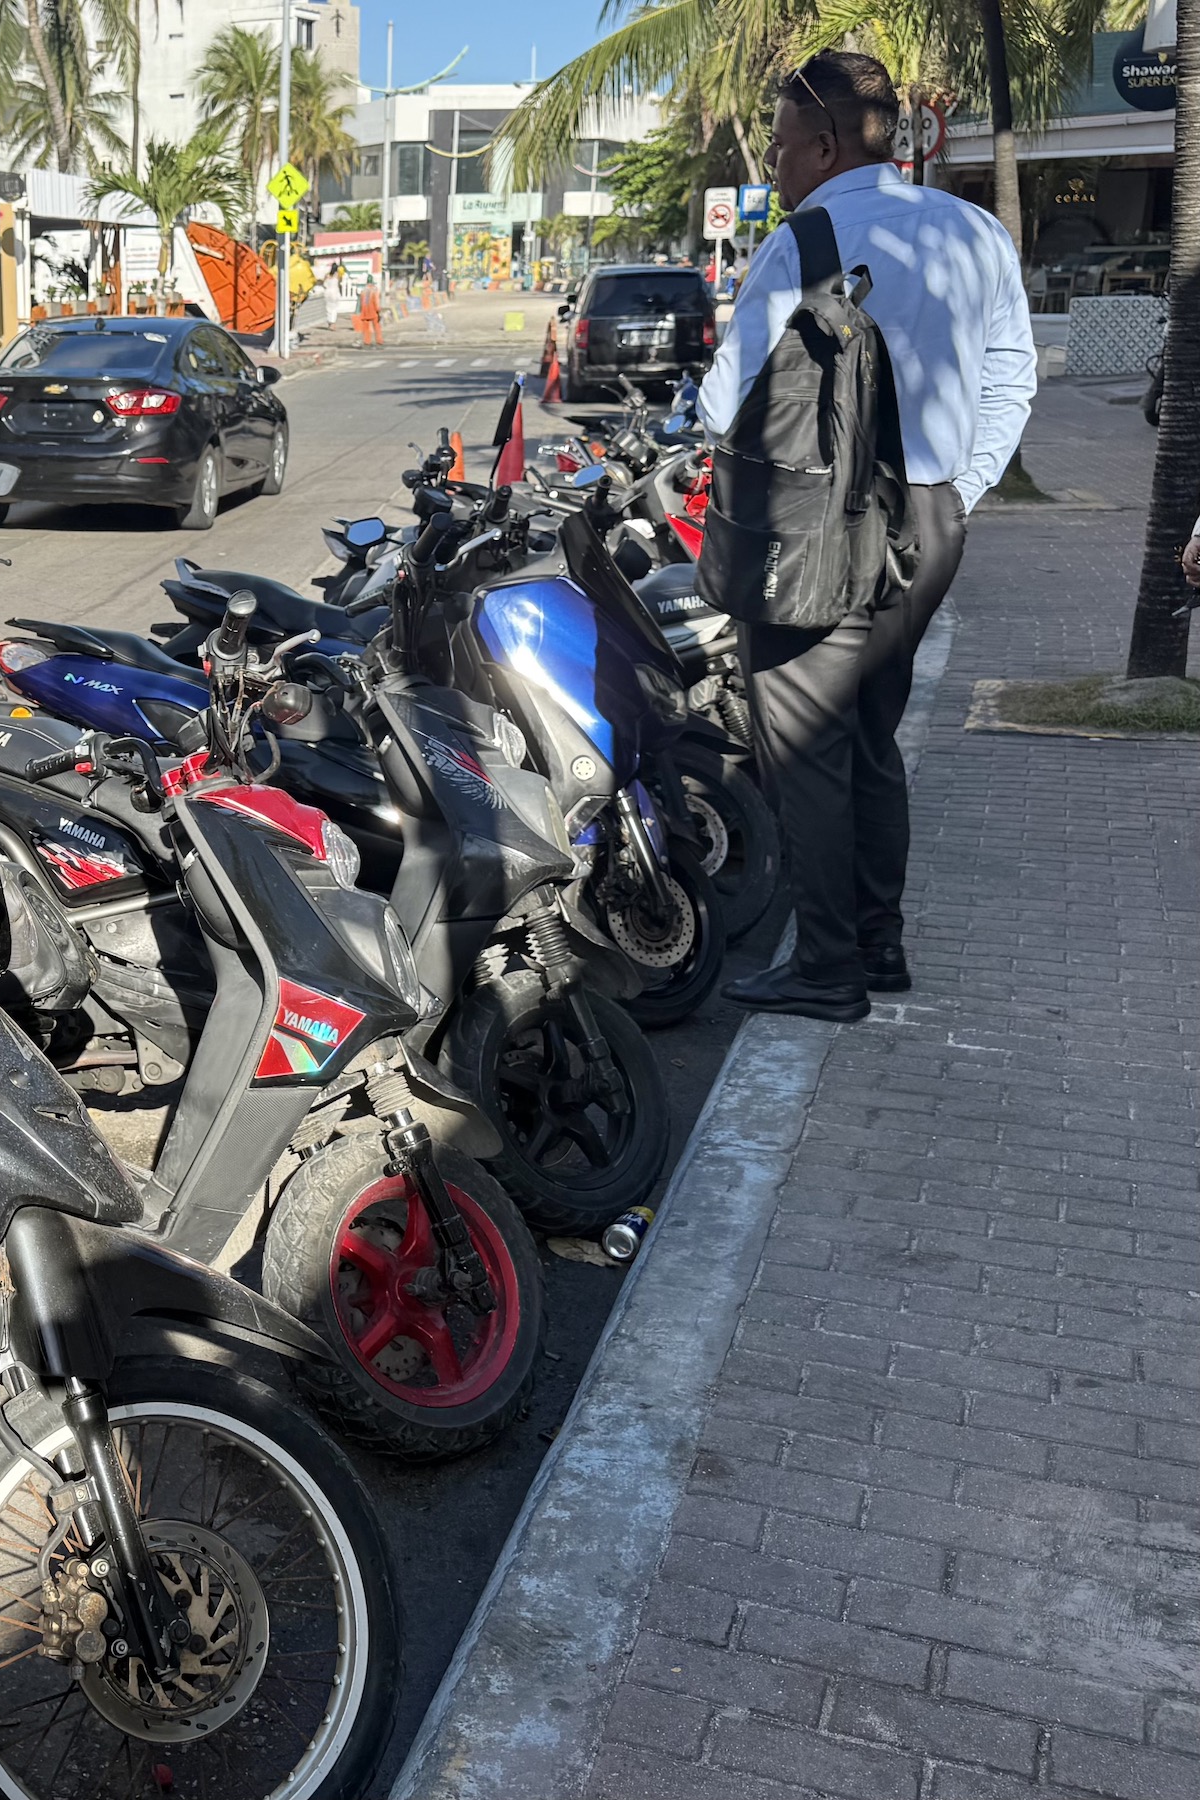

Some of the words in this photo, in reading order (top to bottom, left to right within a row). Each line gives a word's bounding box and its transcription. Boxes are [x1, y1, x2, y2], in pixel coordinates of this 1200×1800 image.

[1128, 76, 1160, 88] SUPER
[1055, 194, 1096, 204] CORAL
[58, 817, 106, 849] YAMAHA
[282, 1008, 340, 1044] YAMAHA
